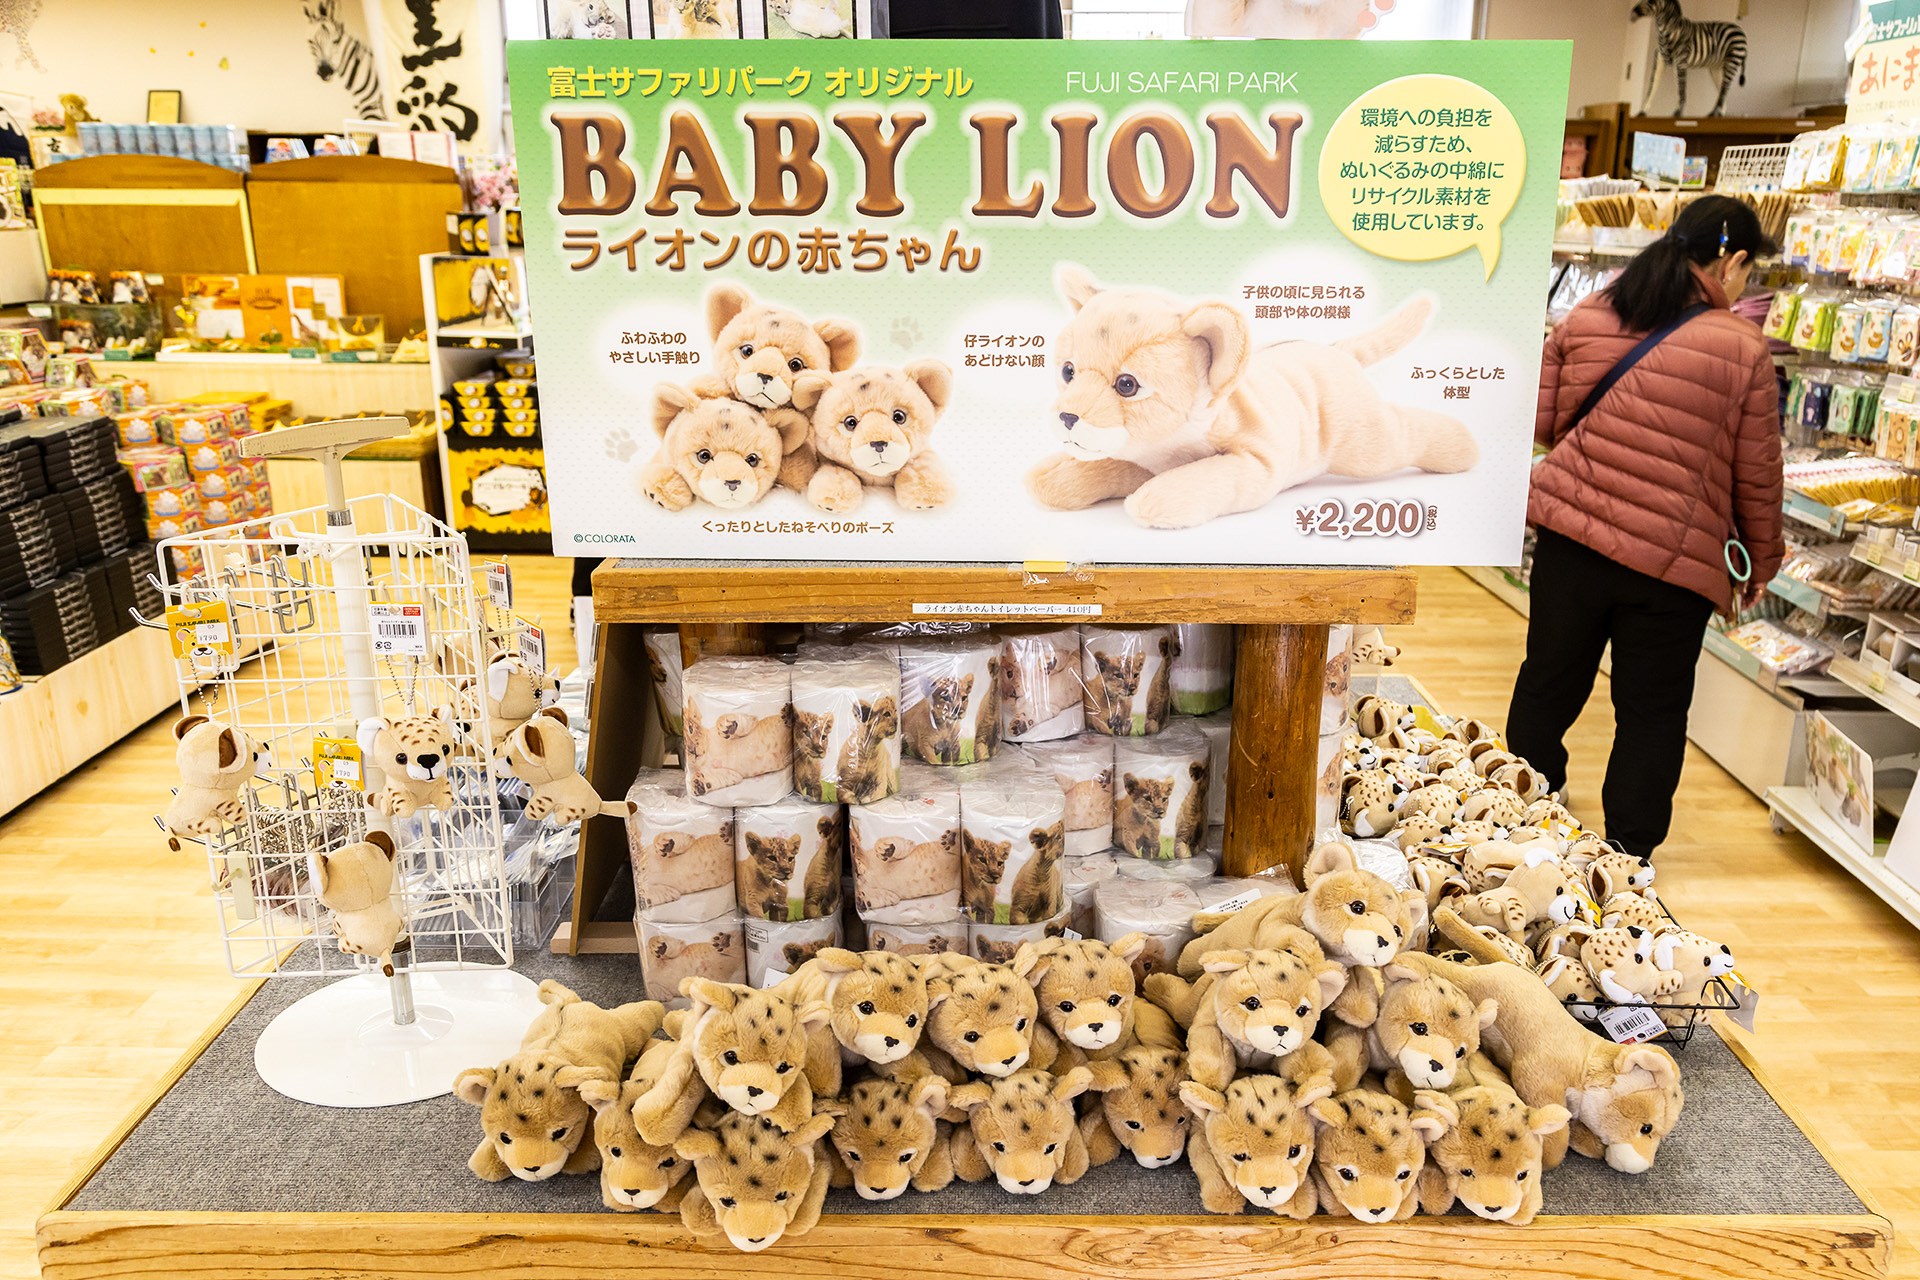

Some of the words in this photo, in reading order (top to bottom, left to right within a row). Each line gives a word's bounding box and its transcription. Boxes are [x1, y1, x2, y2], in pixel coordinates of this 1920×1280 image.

[1858, 44, 1920, 95] あにま
[547, 65, 813, 98] 富士サファリパーク
[824, 65, 974, 98] オリジナル
[1067, 71, 1120, 94] FUJI
[1127, 71, 1221, 94] SAFARI
[1228, 71, 1299, 94] PARK
[1360, 107, 1493, 128] 環境への負担を
[1373, 133, 1474, 155] 減らすため、
[549, 109, 927, 217] BABY
[968, 110, 1304, 219] LION
[1339, 159, 1505, 181] ぬいぐるみの中綿に
[1350, 186, 1492, 207] リサイクル素材を
[1351, 212, 1486, 233] 使用しています。
[562, 227, 983, 274] ライオンの赤ちゃん
[1242, 285, 1366, 300] 子供の頃に見られる
[1254, 304, 1352, 320] 頭部や体の模様
[620, 330, 687, 346] ふわふわの
[963, 333, 1046, 349] 仔ライオンの
[608, 350, 701, 365] やさしい手触り
[963, 353, 1046, 369] あどけない顔
[1410, 365, 1506, 381] ふっくらとした
[1442, 385, 1471, 400] 体型
[701, 519, 895, 535] くったりとしたねそべりのポーズ
[1295, 501, 1420, 538] ¥2,200
[923, 603, 1062, 614] ライオン赤ちゃんトイレットペーパー
